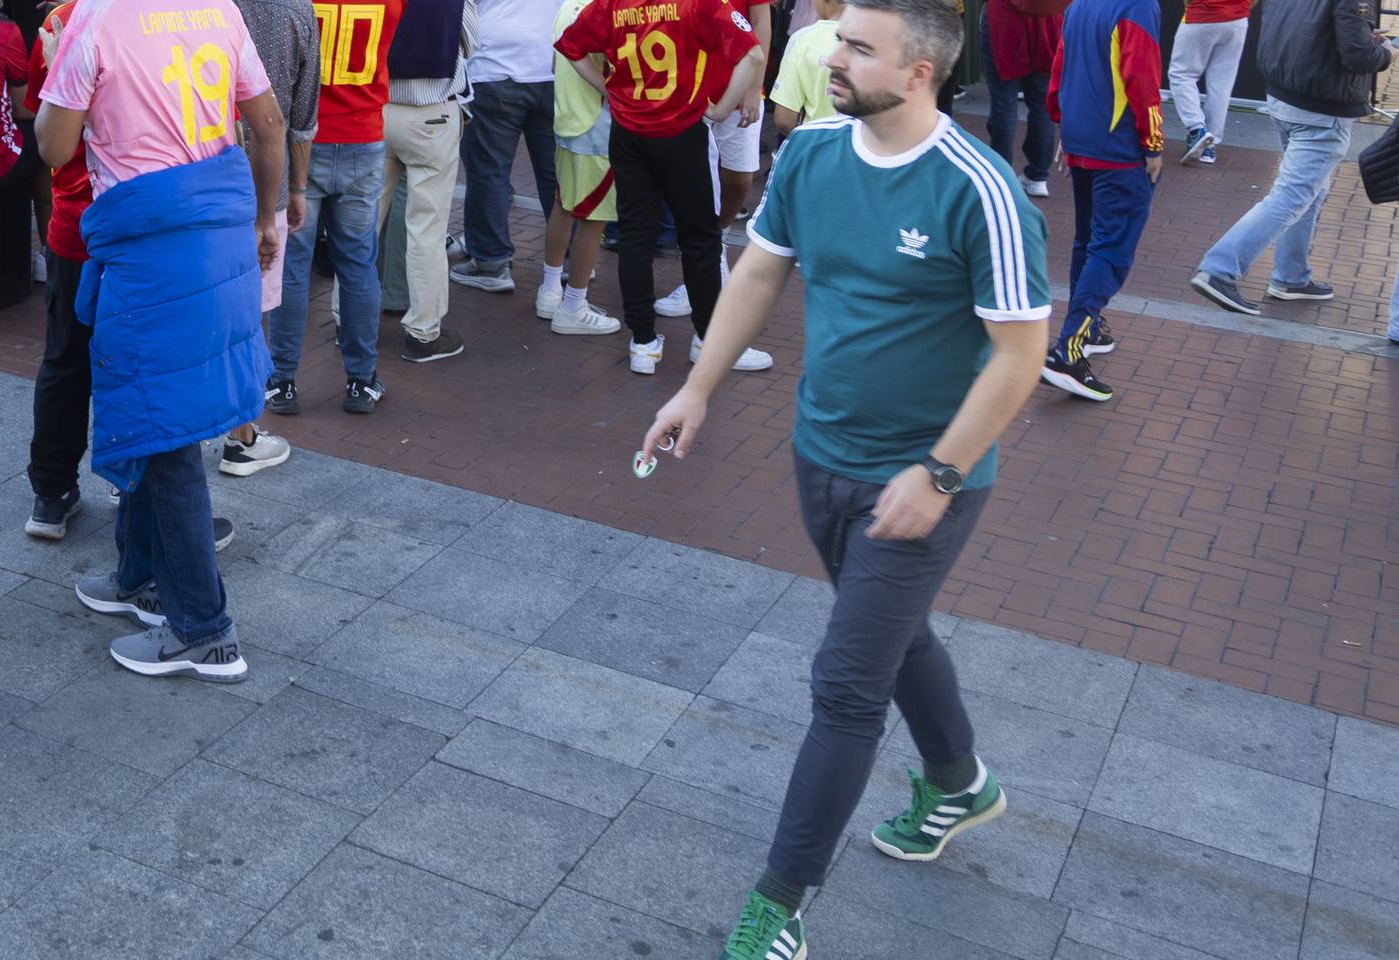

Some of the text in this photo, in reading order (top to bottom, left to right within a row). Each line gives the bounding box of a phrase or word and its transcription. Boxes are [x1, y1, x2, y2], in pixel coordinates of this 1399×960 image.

[138, 8, 229, 36] LAMINE YAMAL
[612, 3, 681, 28] LAMINE YAMAL
[617, 30, 678, 101] 19
[162, 43, 230, 146] 19
[200, 643, 238, 664] AIR
